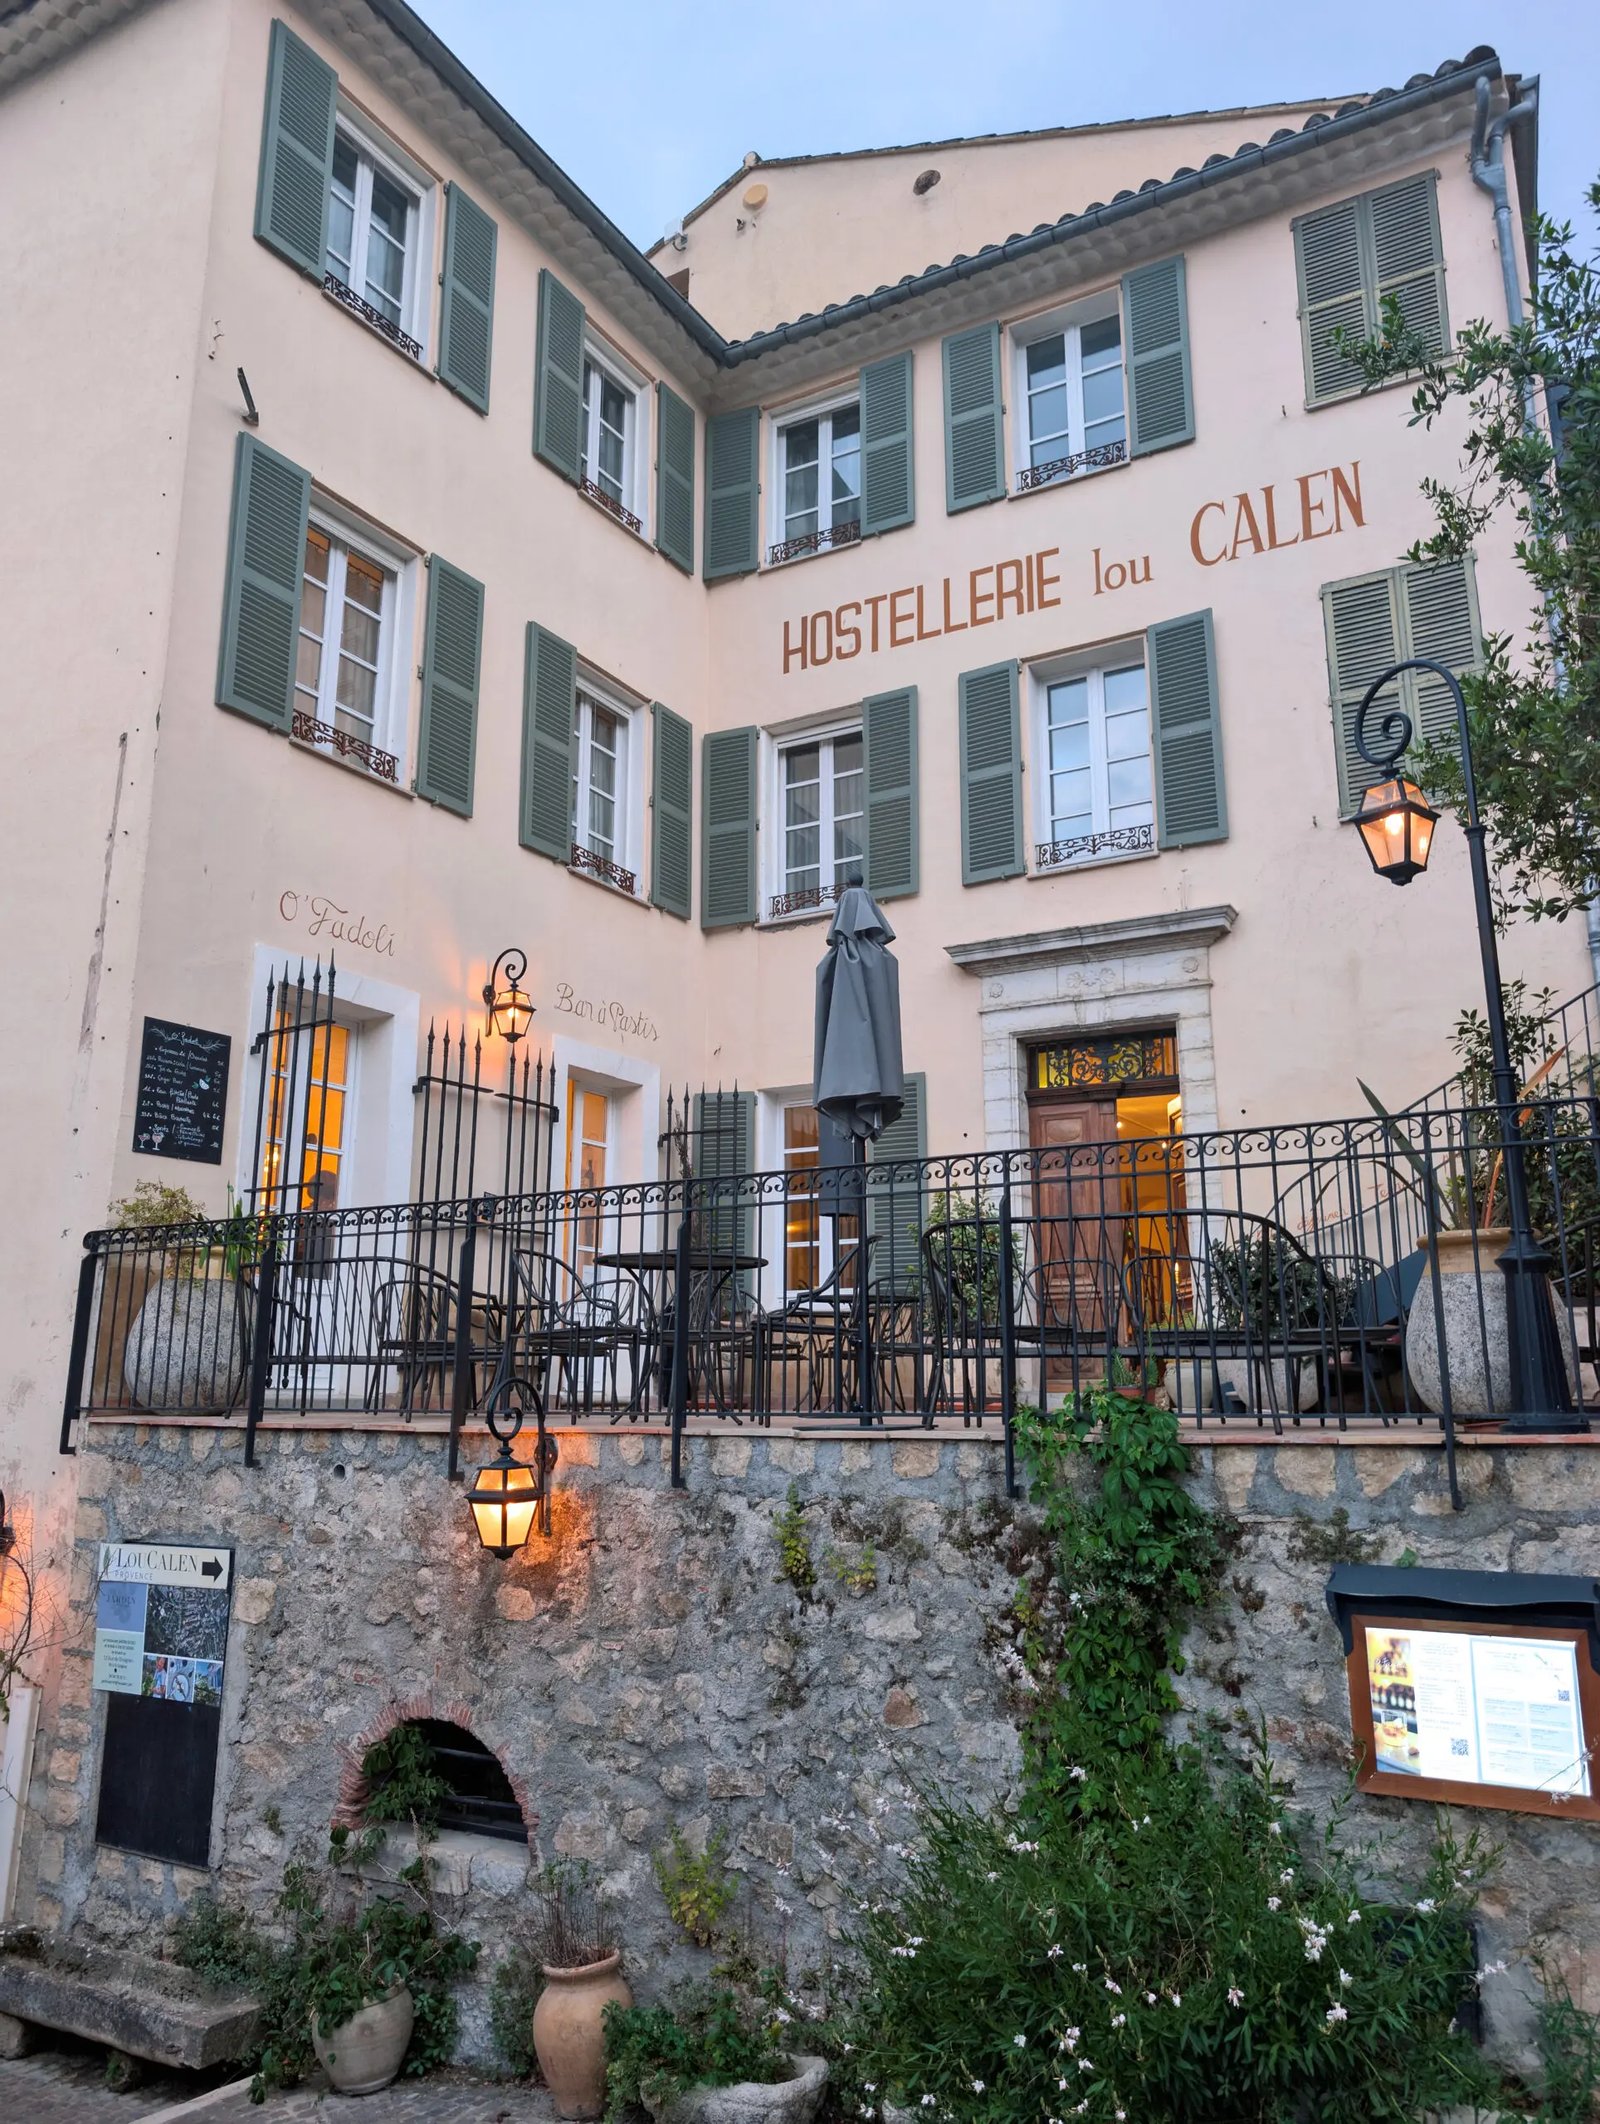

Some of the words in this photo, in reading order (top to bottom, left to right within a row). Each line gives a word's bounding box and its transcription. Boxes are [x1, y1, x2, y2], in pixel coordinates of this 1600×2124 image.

[783, 547, 1061, 674] HOSTELLERIE
[1092, 547, 1155, 595] lou
[1190, 460, 1368, 567] CALEN
[554, 983, 593, 1021] Bar
[609, 1002, 659, 1042] Pastis
[115, 1570, 153, 1581] PROVENCE
